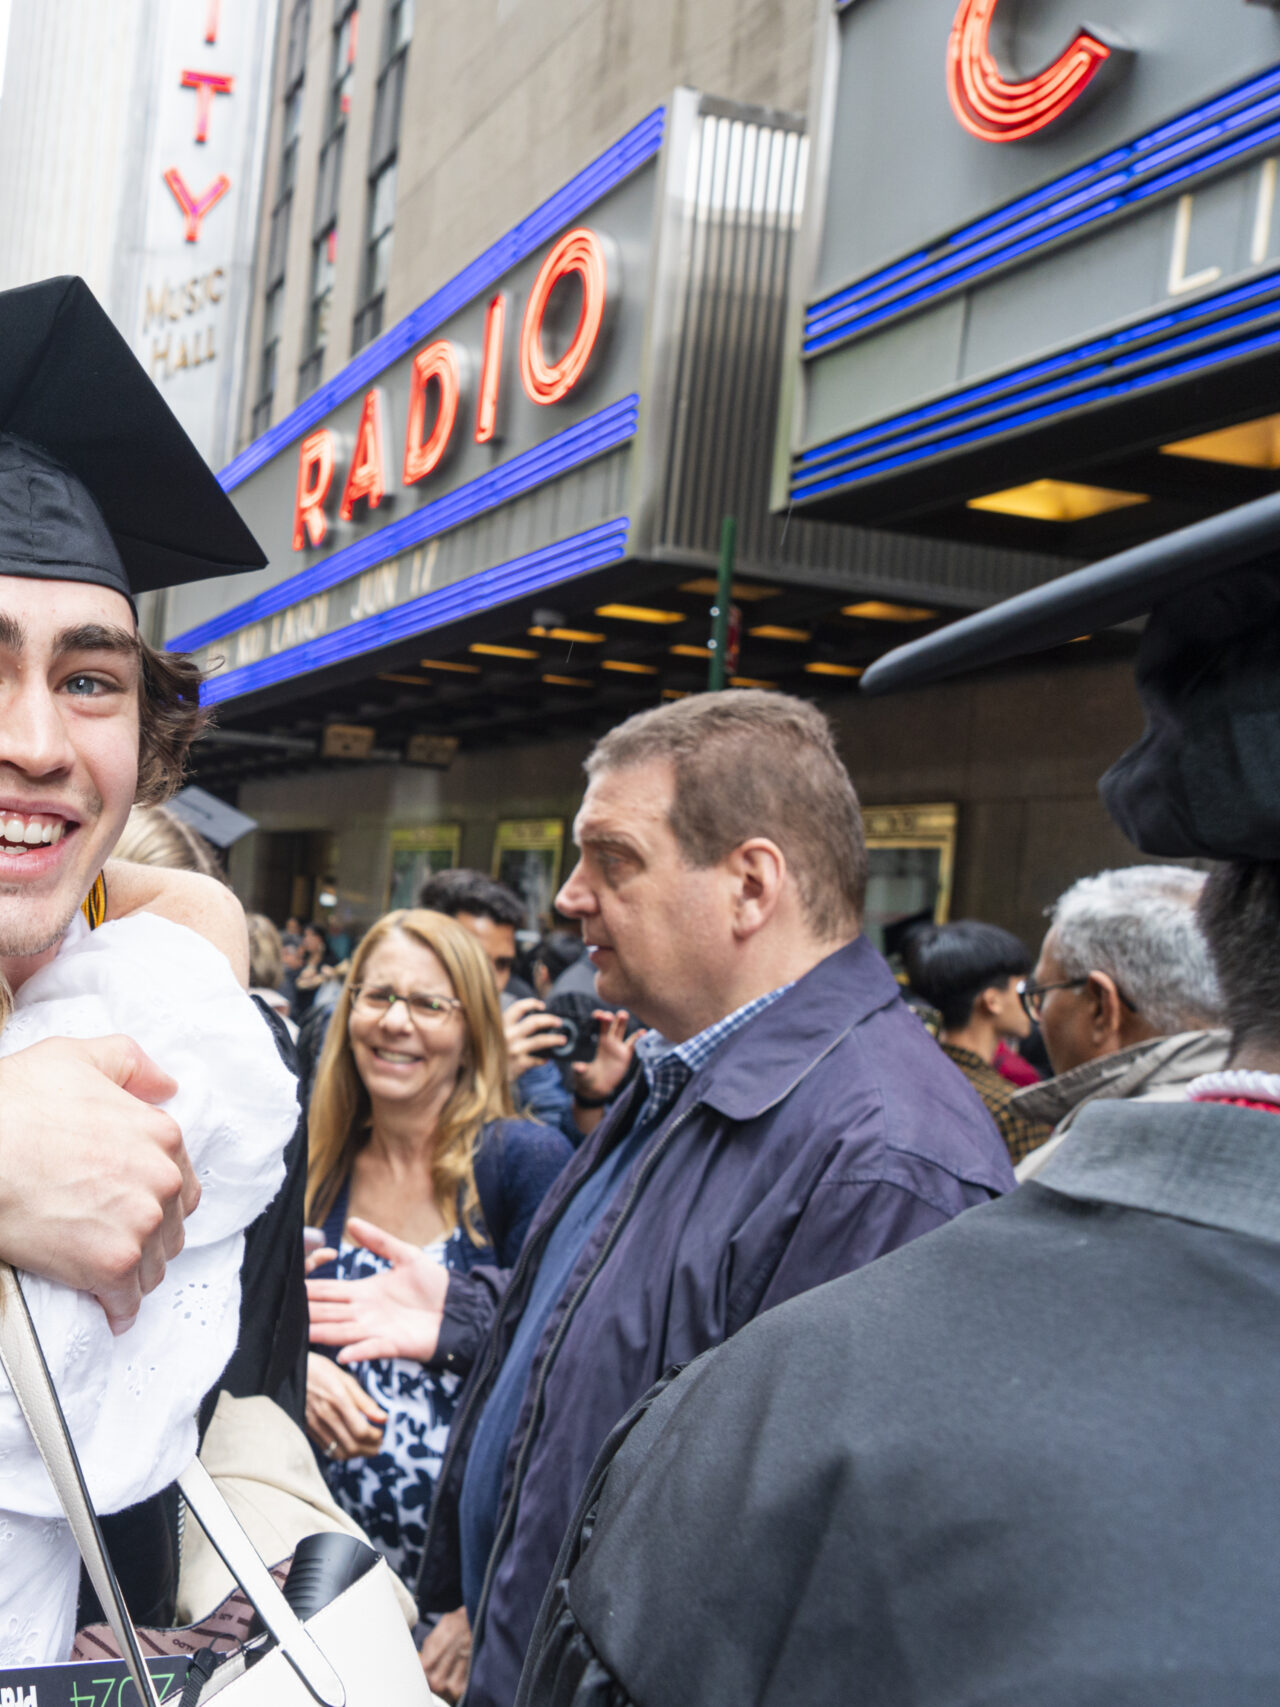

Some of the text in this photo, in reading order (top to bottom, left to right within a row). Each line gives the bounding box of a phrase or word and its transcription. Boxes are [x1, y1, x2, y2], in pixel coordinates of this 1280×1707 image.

[142, 266, 224, 336] MUSIC
[150, 323, 217, 383] HALL
[292, 226, 608, 551] RADIO
[350, 559, 399, 621] JUN
[410, 540, 439, 596] 17
[172, 1638, 197, 1654] ALDO
